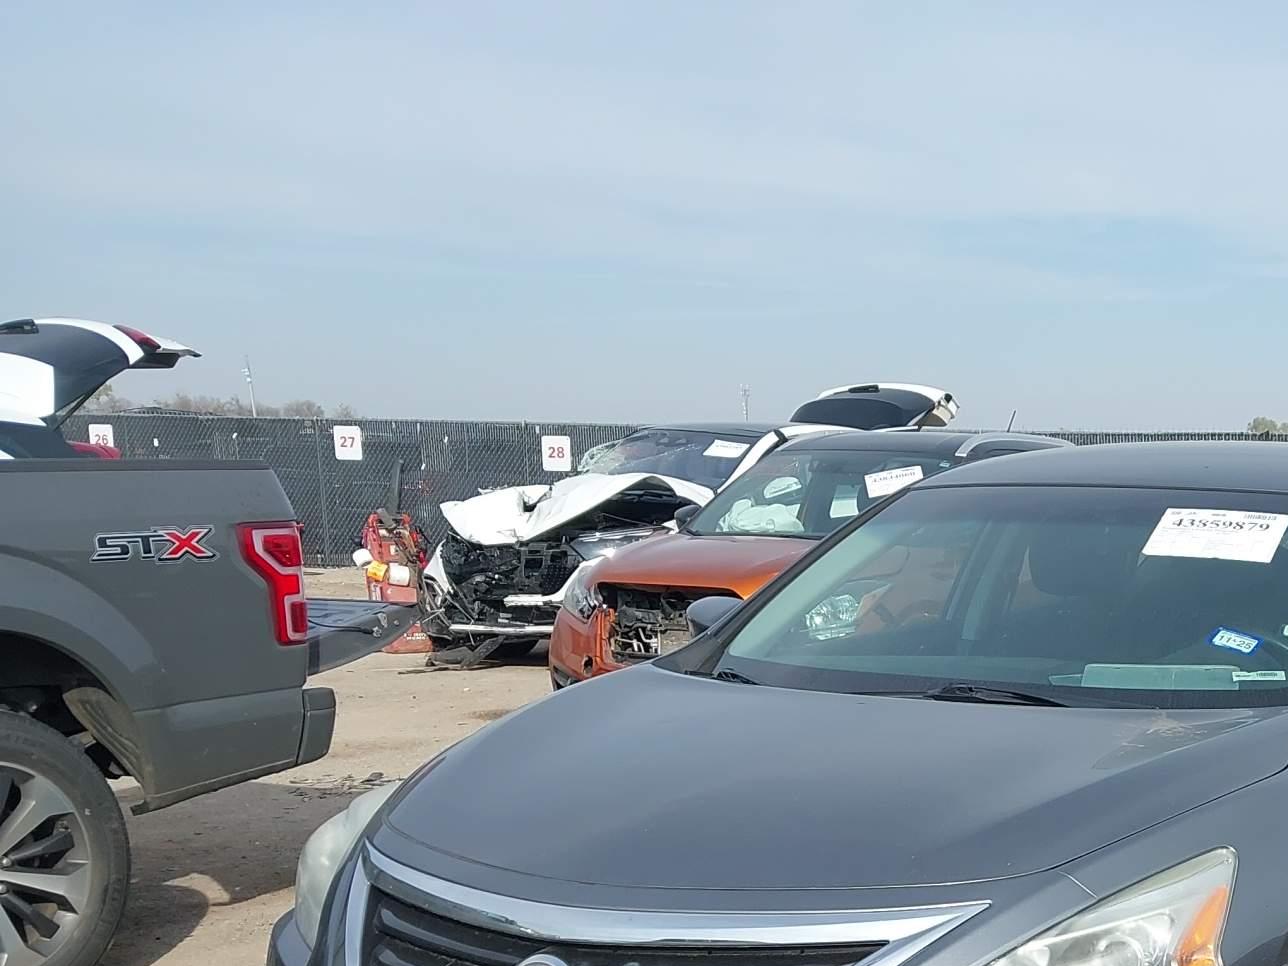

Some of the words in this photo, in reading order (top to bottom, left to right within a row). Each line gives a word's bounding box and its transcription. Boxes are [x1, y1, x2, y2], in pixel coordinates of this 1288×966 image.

[94, 434, 109, 446] 26
[339, 436, 355, 448] 27
[548, 446, 565, 458] 28
[1172, 518, 1271, 532] 43859879
[91, 525, 220, 565] STX
